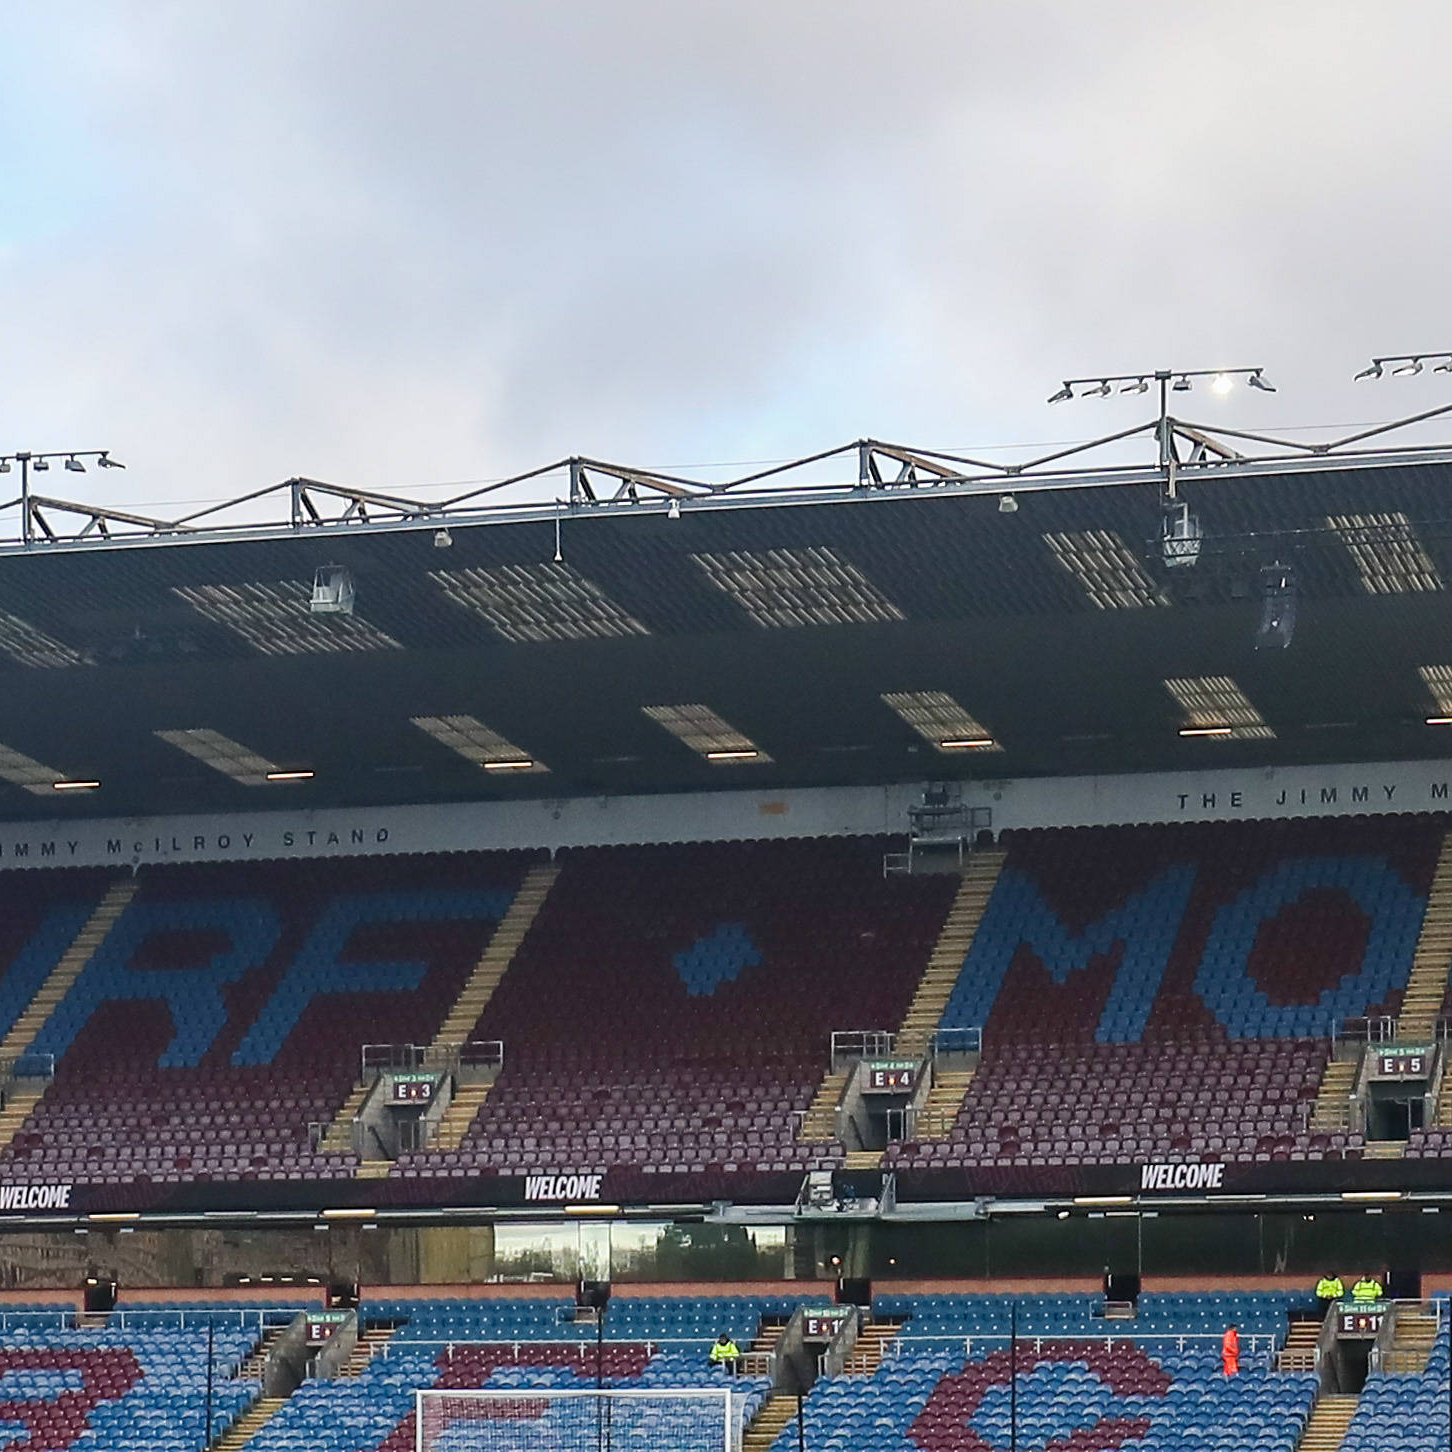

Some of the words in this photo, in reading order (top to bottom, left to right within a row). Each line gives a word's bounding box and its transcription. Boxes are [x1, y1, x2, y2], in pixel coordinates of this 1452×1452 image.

[1177, 791, 1244, 810] THE
[1275, 783, 1397, 806] JIMMY
[106, 833, 254, 855] McILROY
[283, 828, 390, 847] STAND
[1384, 1058, 1393, 1072] E
[1411, 1058, 1420, 1072] 5
[875, 1072, 884, 1086] E
[900, 1072, 909, 1085] 4
[398, 1084, 406, 1098] E
[422, 1084, 430, 1097] 3
[1141, 1162, 1225, 1190] WELCOME
[524, 1174, 603, 1201] WELCOME
[0, 1185, 72, 1210] WELCOME
[809, 1320, 818, 1334] E
[1344, 1315, 1354, 1330] E
[311, 1325, 320, 1338] E
